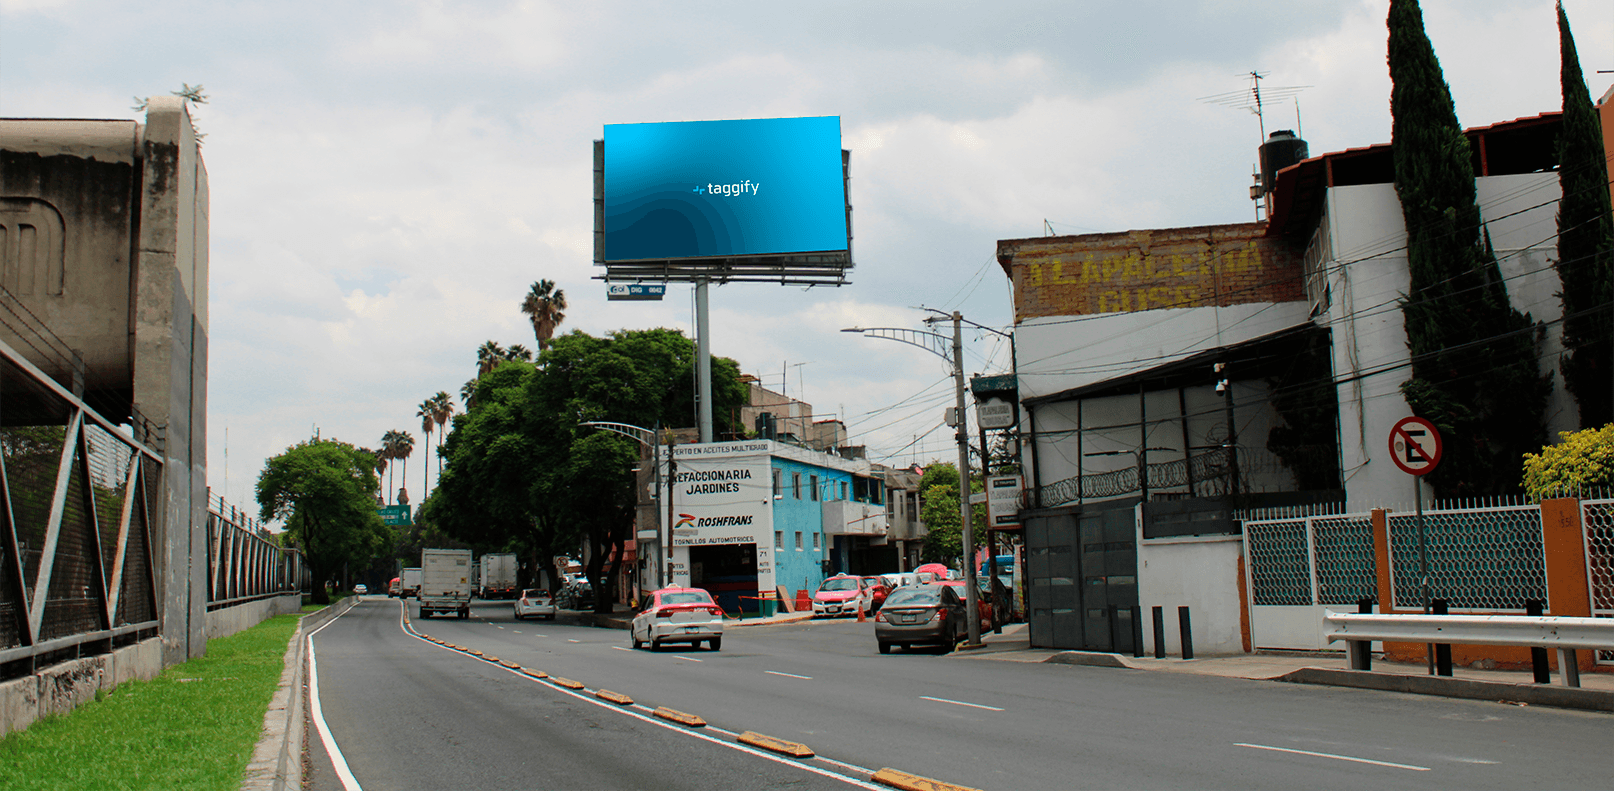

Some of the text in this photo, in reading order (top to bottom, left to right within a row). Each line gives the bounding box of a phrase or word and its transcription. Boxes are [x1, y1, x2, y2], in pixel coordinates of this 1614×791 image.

[707, 180, 760, 197] taggify
[663, 447, 692, 456] EPERTO
[693, 446, 702, 455] EN
[703, 445, 731, 454] ACEITES
[731, 443, 769, 453] MULTIGRADO
[686, 482, 740, 495] JARDINES
[697, 515, 753, 528] ROSHFRANS
[708, 535, 755, 544] AUTOMOTRICES
